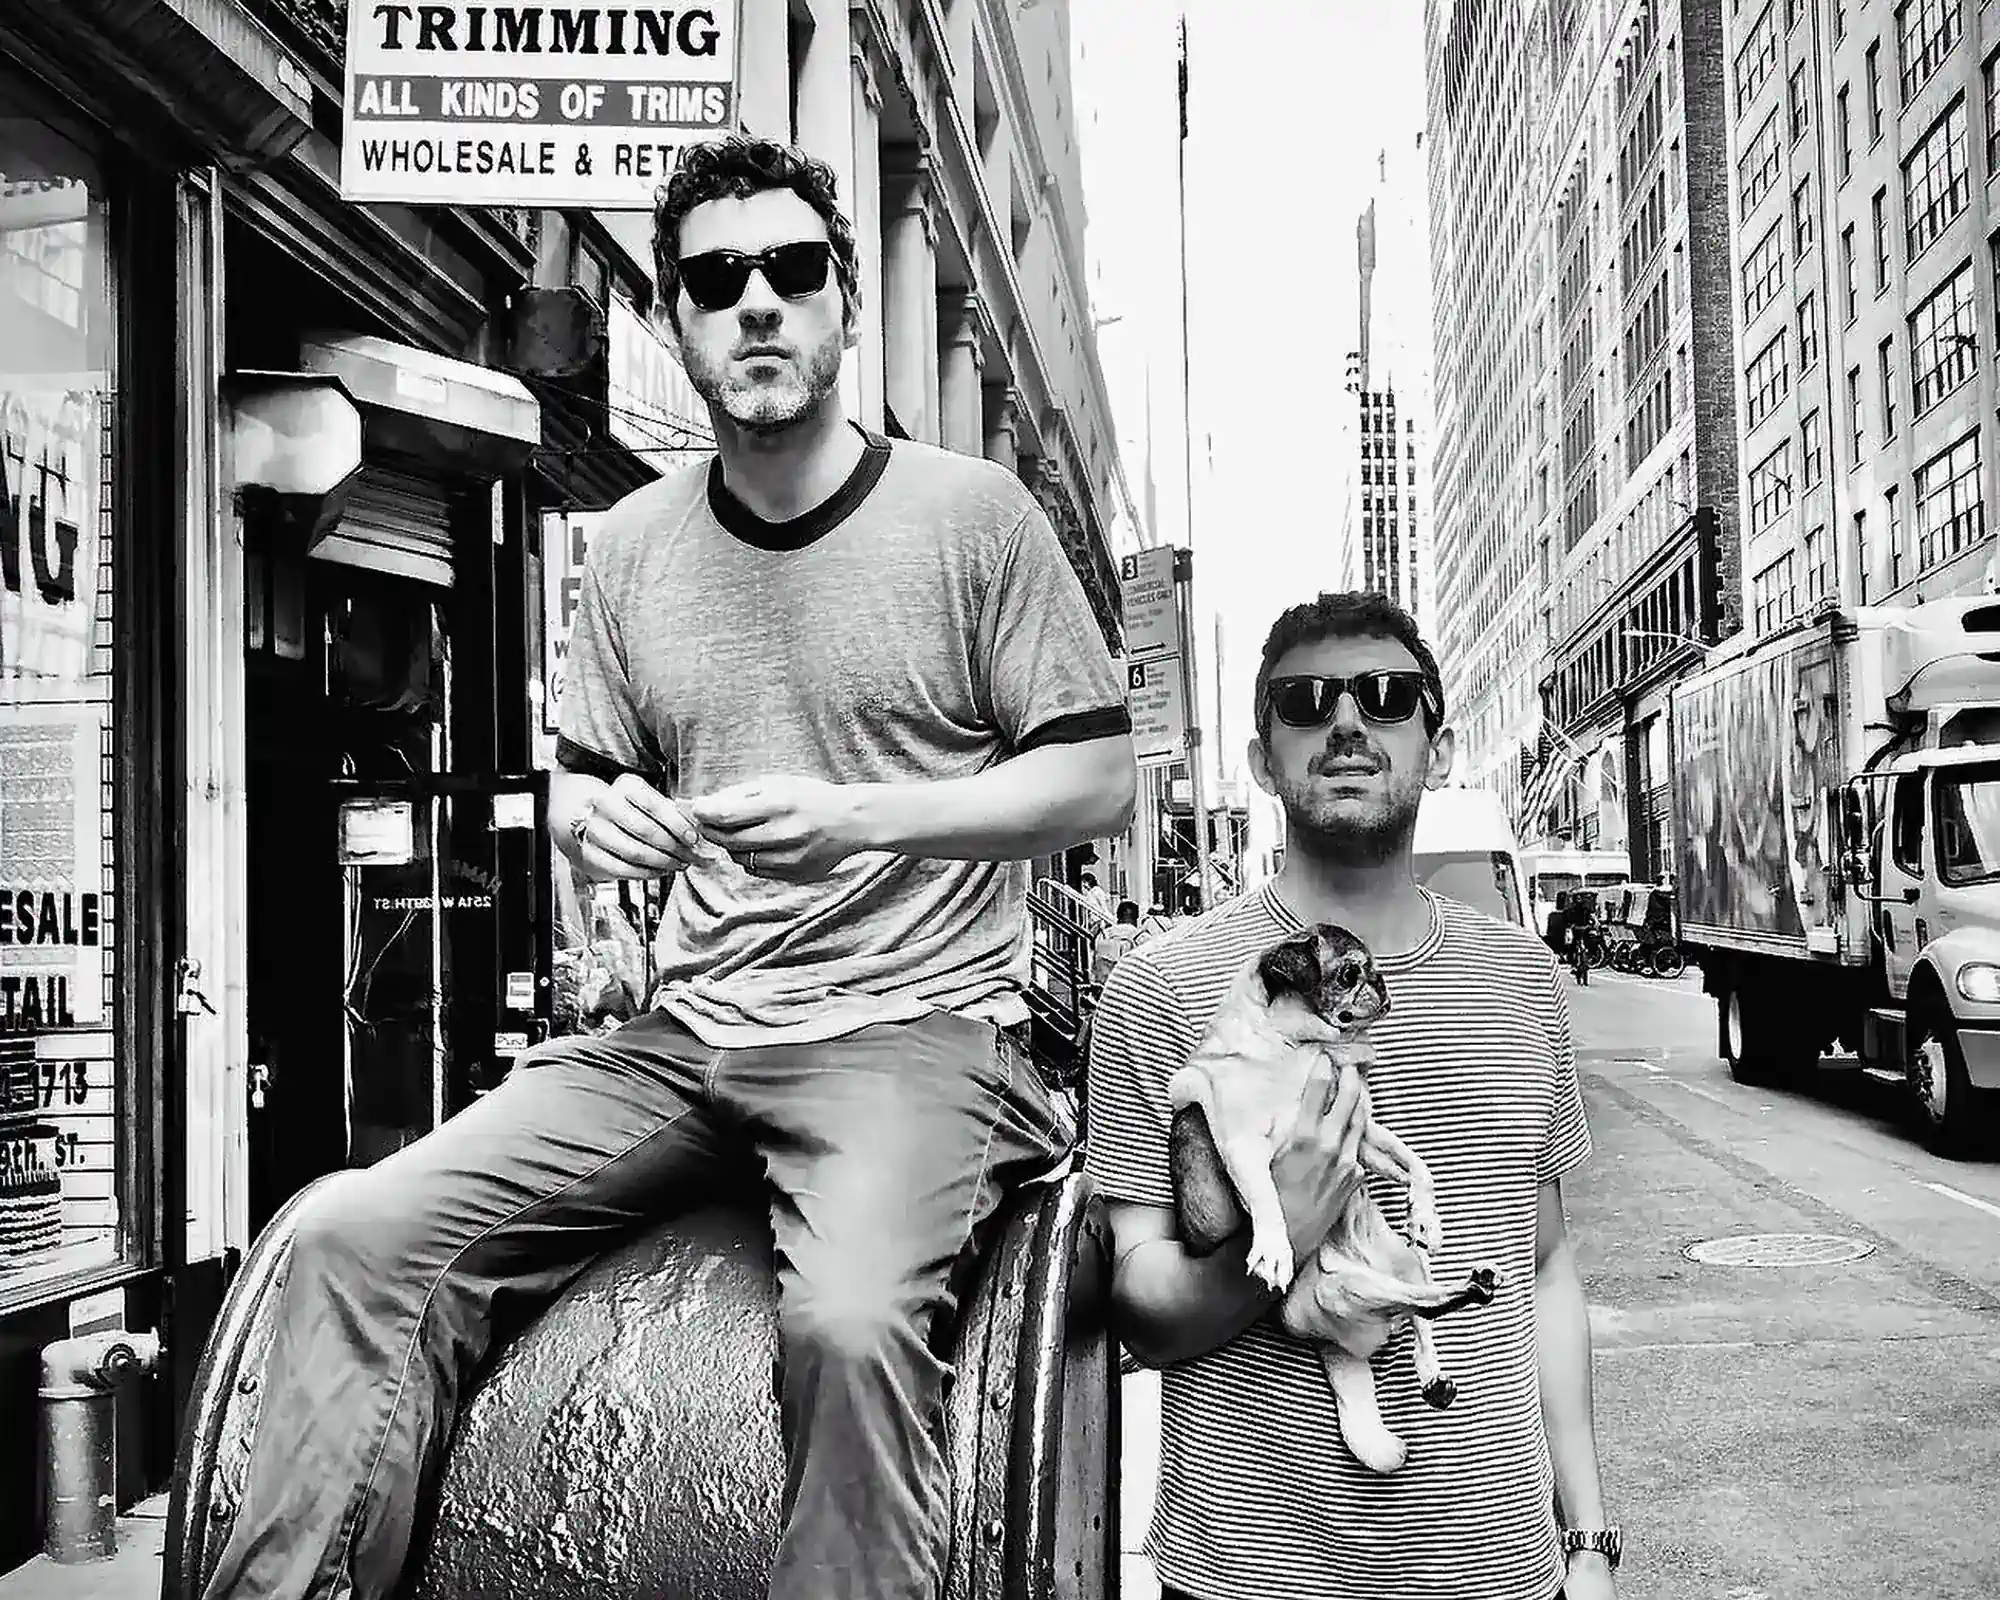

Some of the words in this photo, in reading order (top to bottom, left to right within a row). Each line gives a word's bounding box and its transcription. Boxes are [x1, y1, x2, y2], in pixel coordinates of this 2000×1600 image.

[373, 5, 721, 57] TRIMMING
[359, 80, 420, 116] ALL
[440, 82, 540, 119] KINDS
[560, 84, 605, 120] OF
[626, 85, 725, 124] TRIMS
[361, 139, 556, 176] WHOLESALE
[574, 143, 593, 176] &
[1126, 558, 1135, 577] 3
[1132, 667, 1142, 687] 6
[0, 889, 99, 947] ESALE
[1, 975, 75, 1029] TAIL
